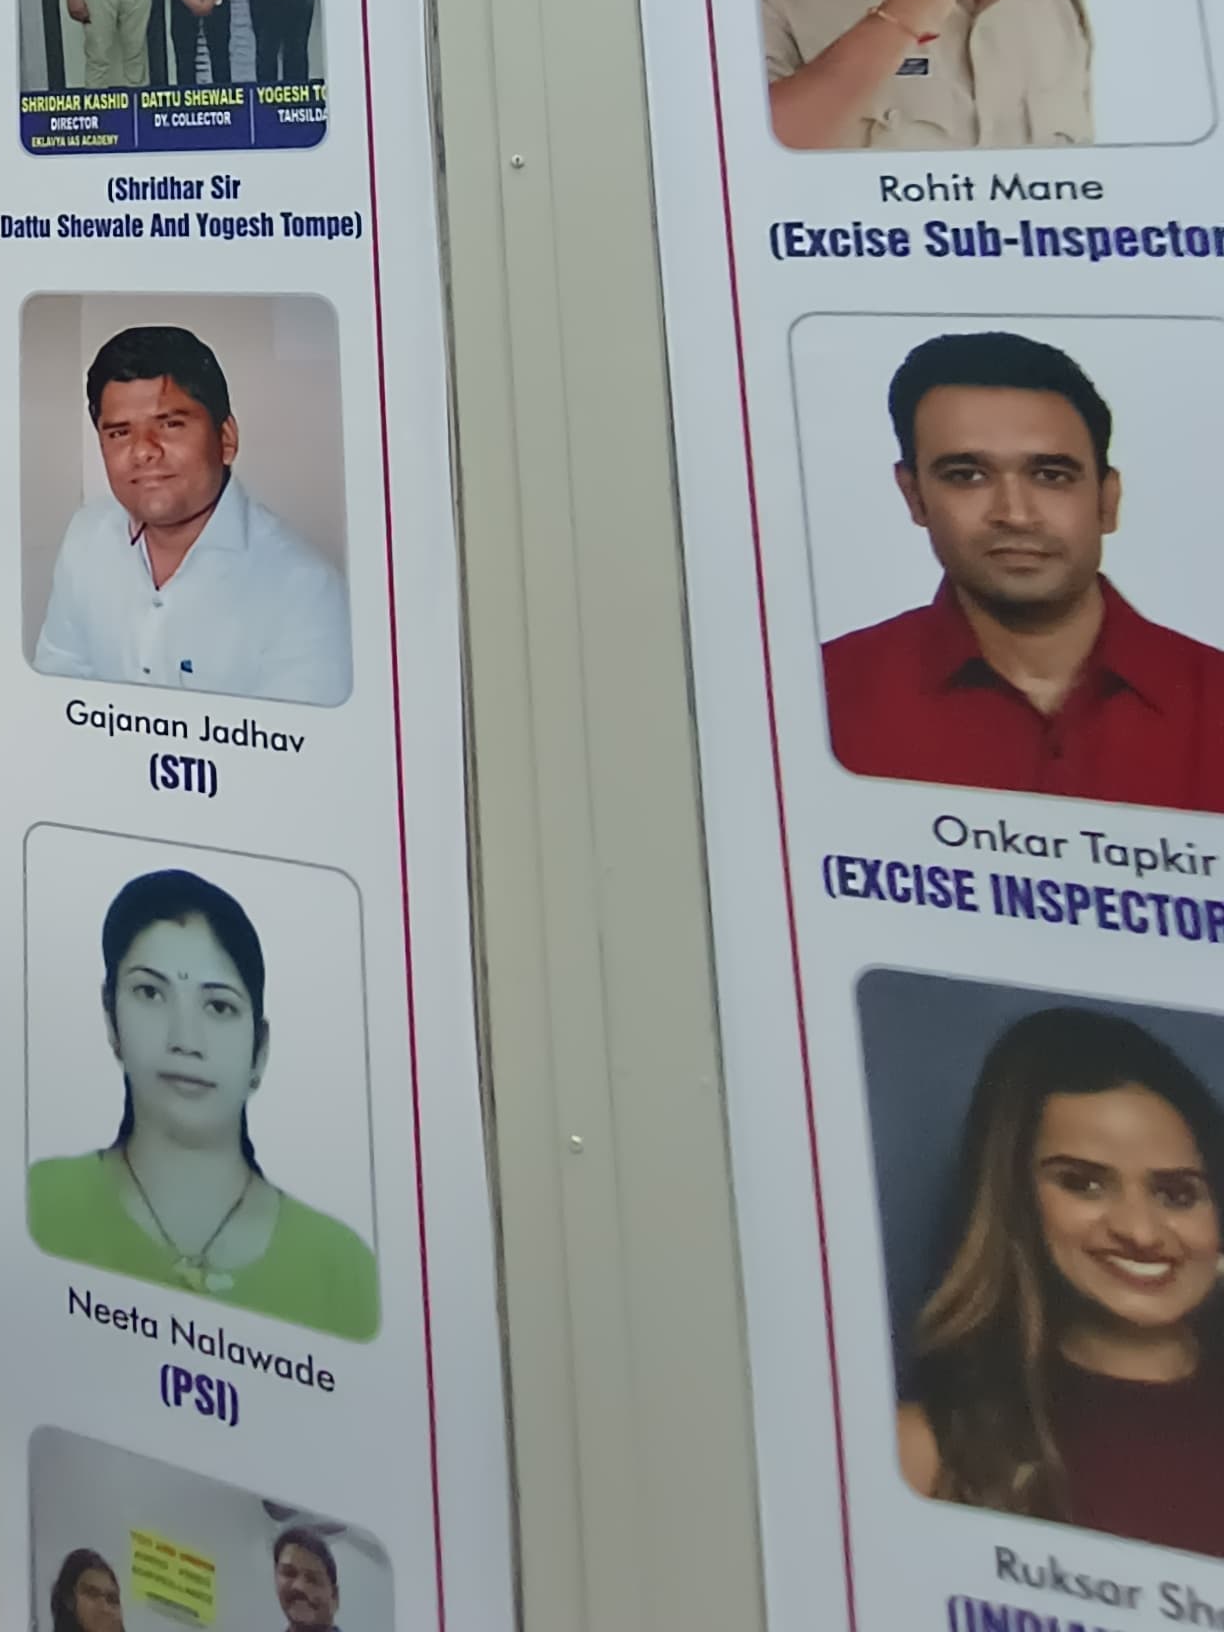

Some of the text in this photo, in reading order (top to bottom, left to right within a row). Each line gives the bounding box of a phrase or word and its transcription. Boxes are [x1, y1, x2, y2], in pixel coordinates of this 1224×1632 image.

[21, 93, 129, 113] SHRIDHAR KASHID
[141, 88, 244, 108] DATTU SHEWALE
[257, 85, 310, 104] YOGESH
[51, 116, 99, 131] DIRECTOR
[154, 111, 232, 127] DY. COLLECTOR
[107, 174, 241, 203] (Shridhar Sir
[879, 172, 1105, 203] Rohit Mane
[0, 211, 362, 241] Dattu Shewale And Yogesh Tompe)
[769, 221, 912, 261] (Excise
[66, 699, 306, 754] Gajanan Jadhav
[149, 752, 218, 799] (STI)
[932, 814, 1218, 880] Onkar Tapkir
[822, 853, 980, 913] (EXCISE
[68, 1286, 336, 1392] Neeta Nalawade
[160, 1363, 239, 1427] (PSI)
[994, 1544, 1144, 1610] Ruksar
